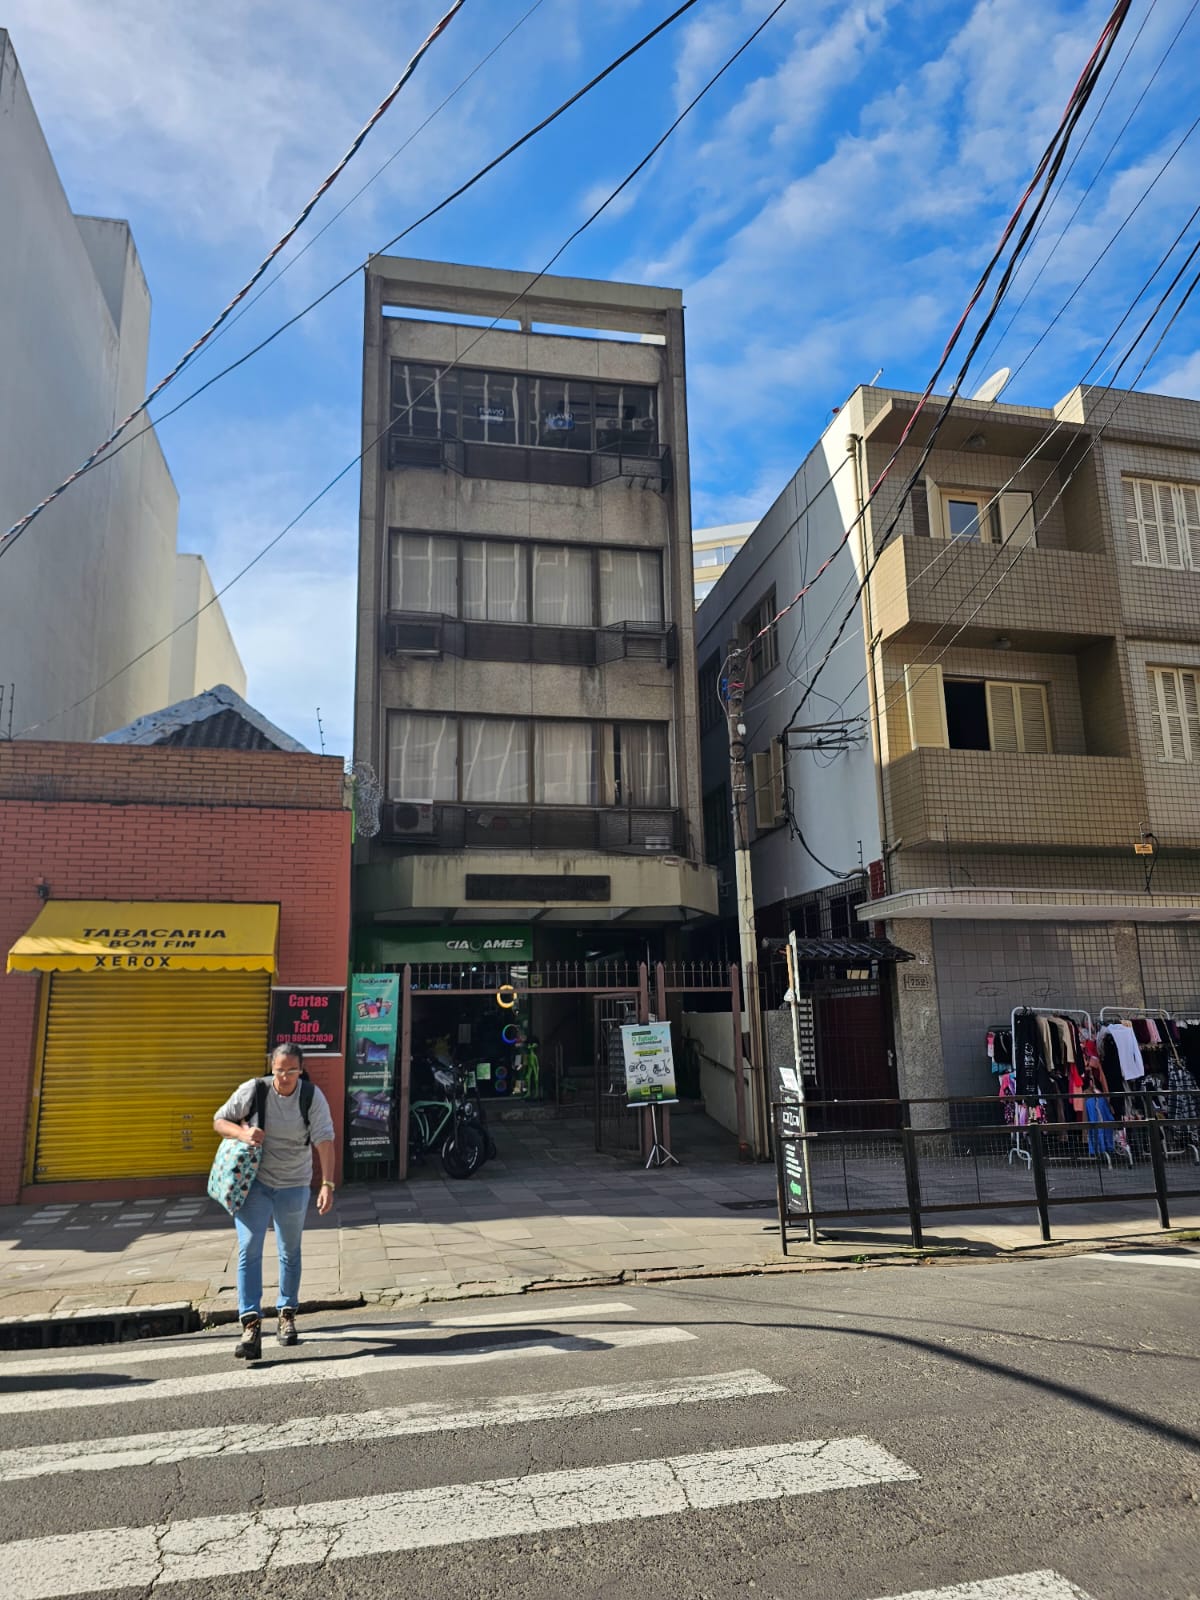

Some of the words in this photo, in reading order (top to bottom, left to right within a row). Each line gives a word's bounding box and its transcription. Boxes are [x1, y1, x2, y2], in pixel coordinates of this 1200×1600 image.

[82, 928, 227, 939] TABACARIA
[108, 939, 157, 949] BOM
[163, 940, 197, 949] FIM
[95, 955, 171, 968] XEROX
[288, 993, 329, 1008] Cartas
[300, 1009, 311, 1021] &
